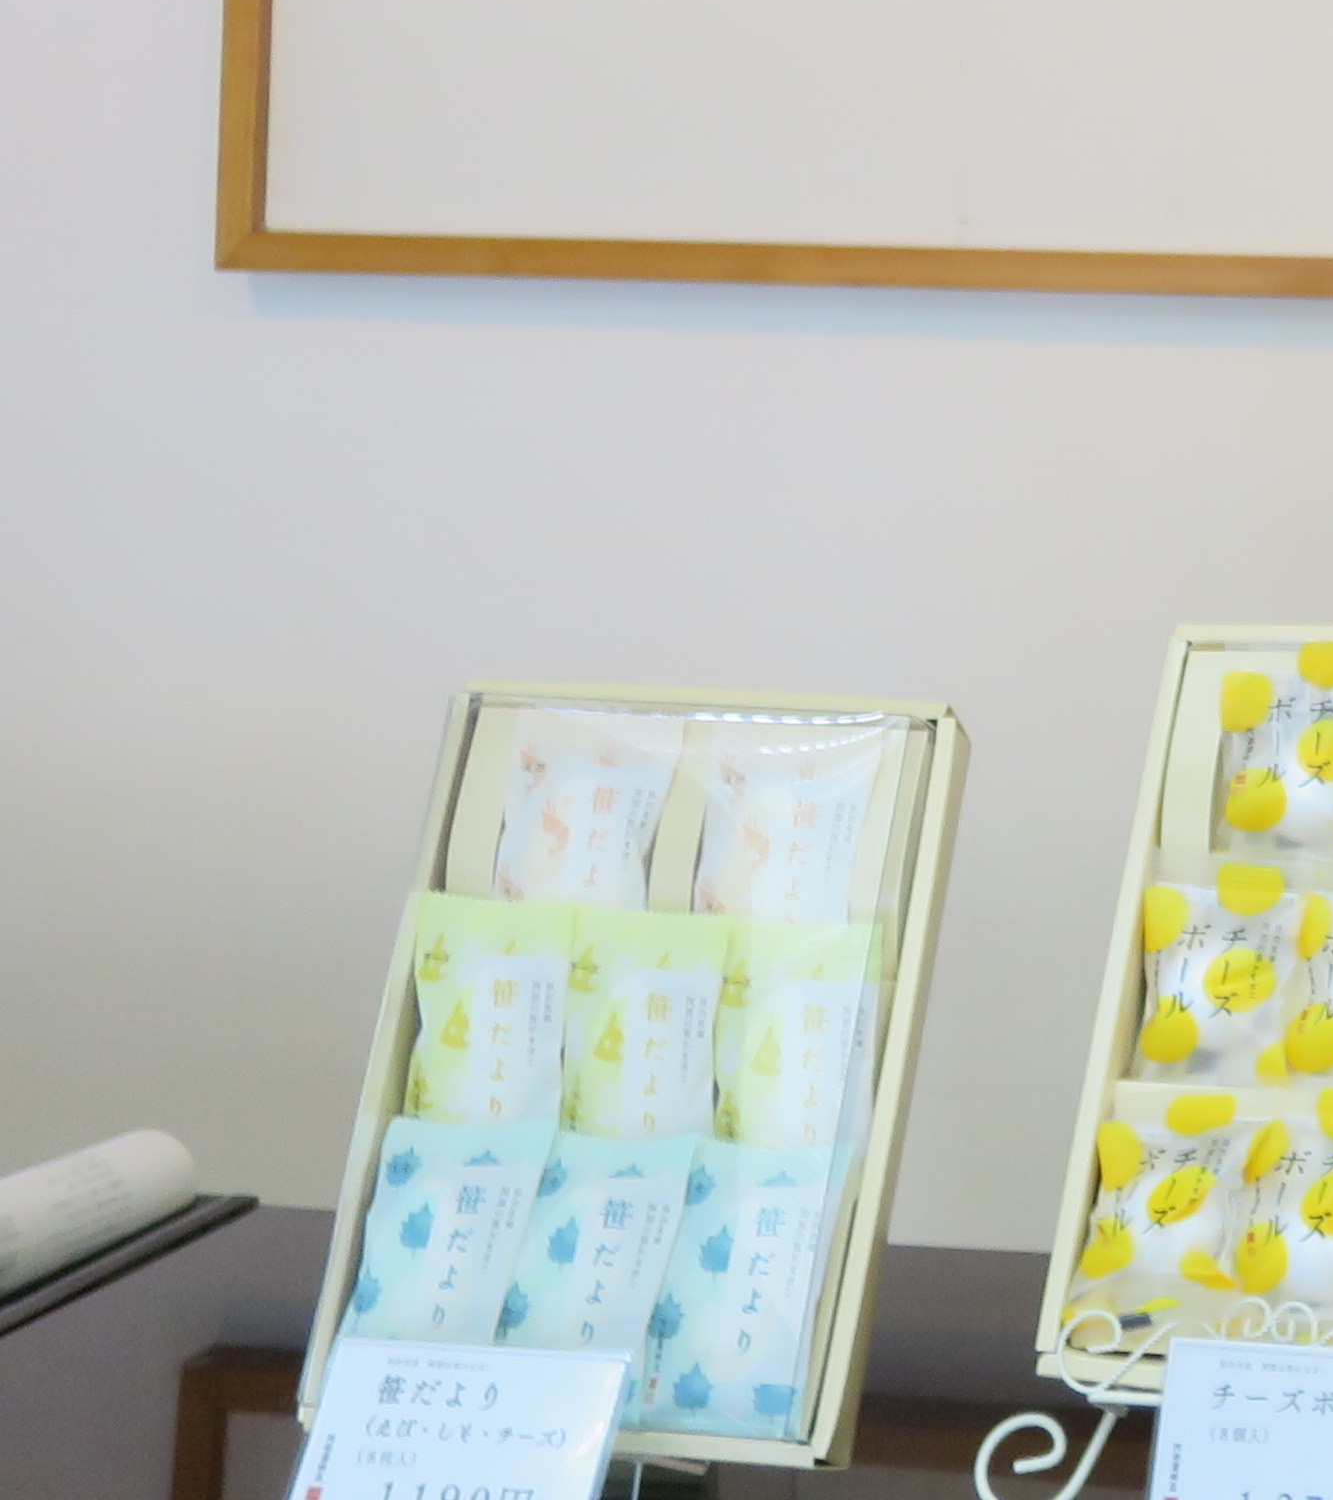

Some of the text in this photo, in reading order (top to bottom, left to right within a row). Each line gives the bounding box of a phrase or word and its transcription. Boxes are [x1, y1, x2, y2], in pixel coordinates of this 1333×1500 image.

[1257, 697, 1297, 789] ボール
[1164, 925, 1212, 1019] ボール
[1208, 928, 1248, 1019] チーズ
[489, 978, 518, 1120] 笹だより
[642, 993, 674, 1136] 笹だより
[1141, 1148, 1198, 1235] チーズ
[1263, 1150, 1313, 1246] ボール
[432, 1184, 487, 1330] 笹だより
[580, 1197, 635, 1346] 笹だより
[737, 1206, 787, 1354] 笹だより
[378, 1373, 499, 1411] 笹だより
